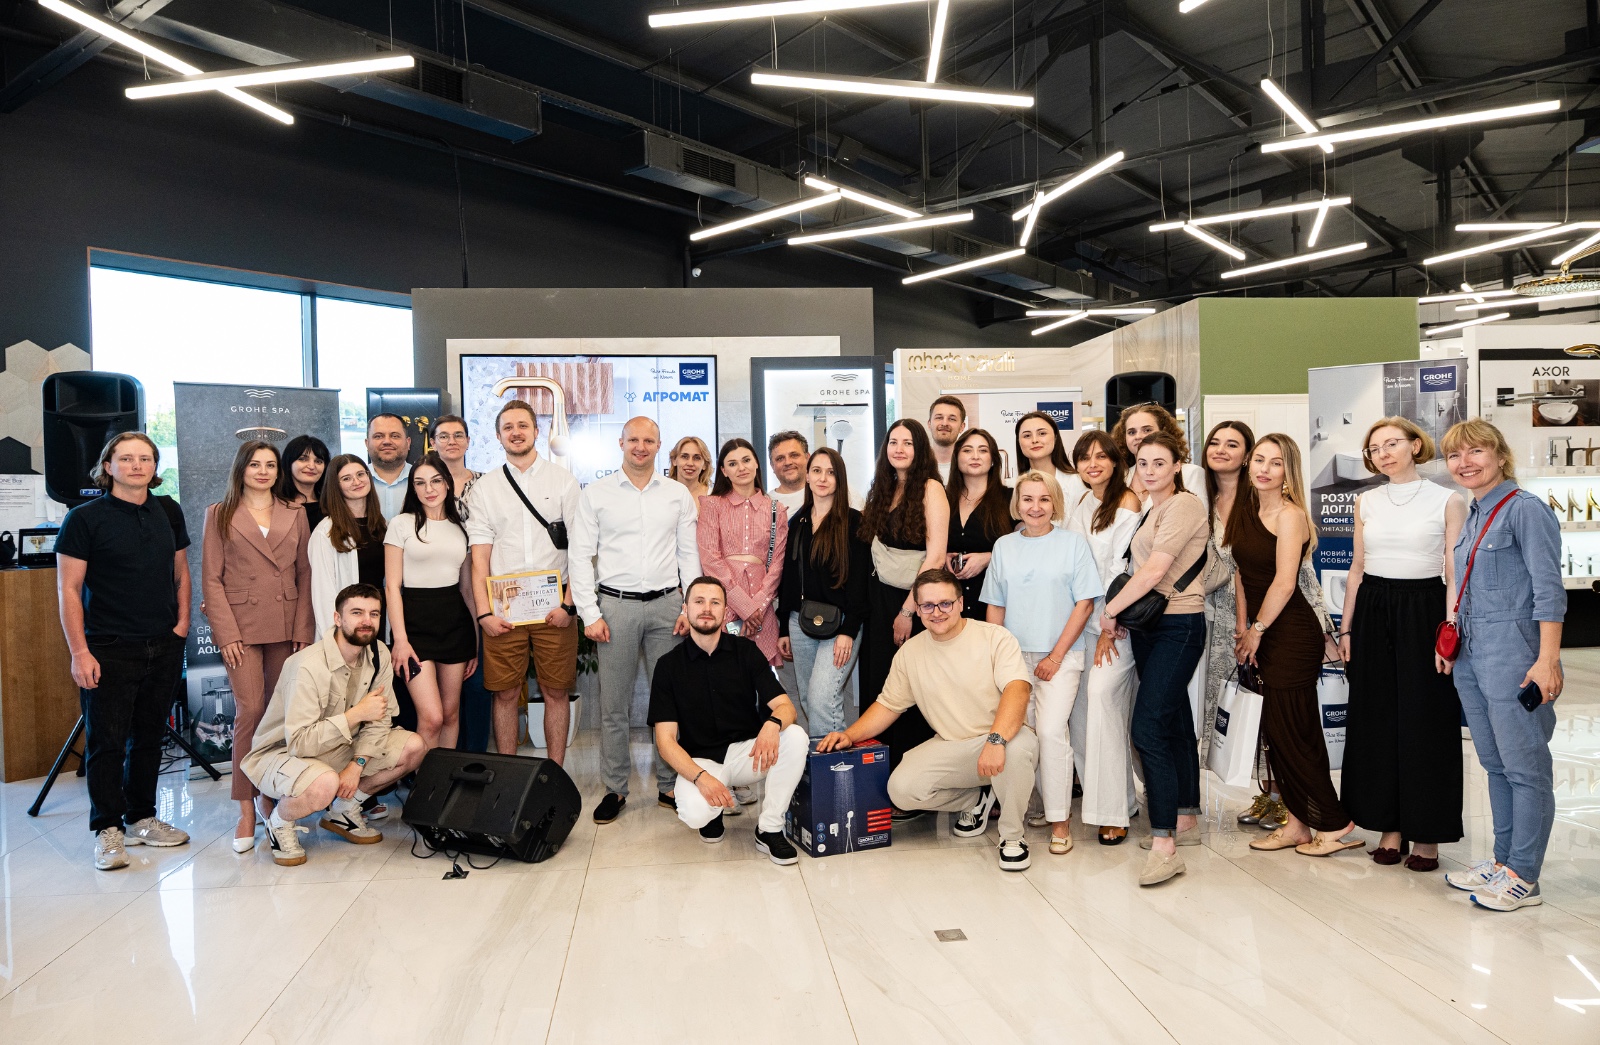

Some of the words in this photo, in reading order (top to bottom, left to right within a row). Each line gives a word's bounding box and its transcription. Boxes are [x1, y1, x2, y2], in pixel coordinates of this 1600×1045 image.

[908, 352, 963, 373] roberto
[966, 351, 1015, 373] cavalli
[1532, 366, 1570, 377] AXOR
[1423, 372, 1453, 381] GROHE
[643, 391, 710, 402] АГРОМАТ
[230, 405, 267, 413] GROHE
[531, 598, 550, 607] 10%
[196, 625, 213, 634] GR
[197, 636, 212, 645] RA
[197, 645, 221, 655] AQU
[1325, 709, 1347, 717] GROHE
